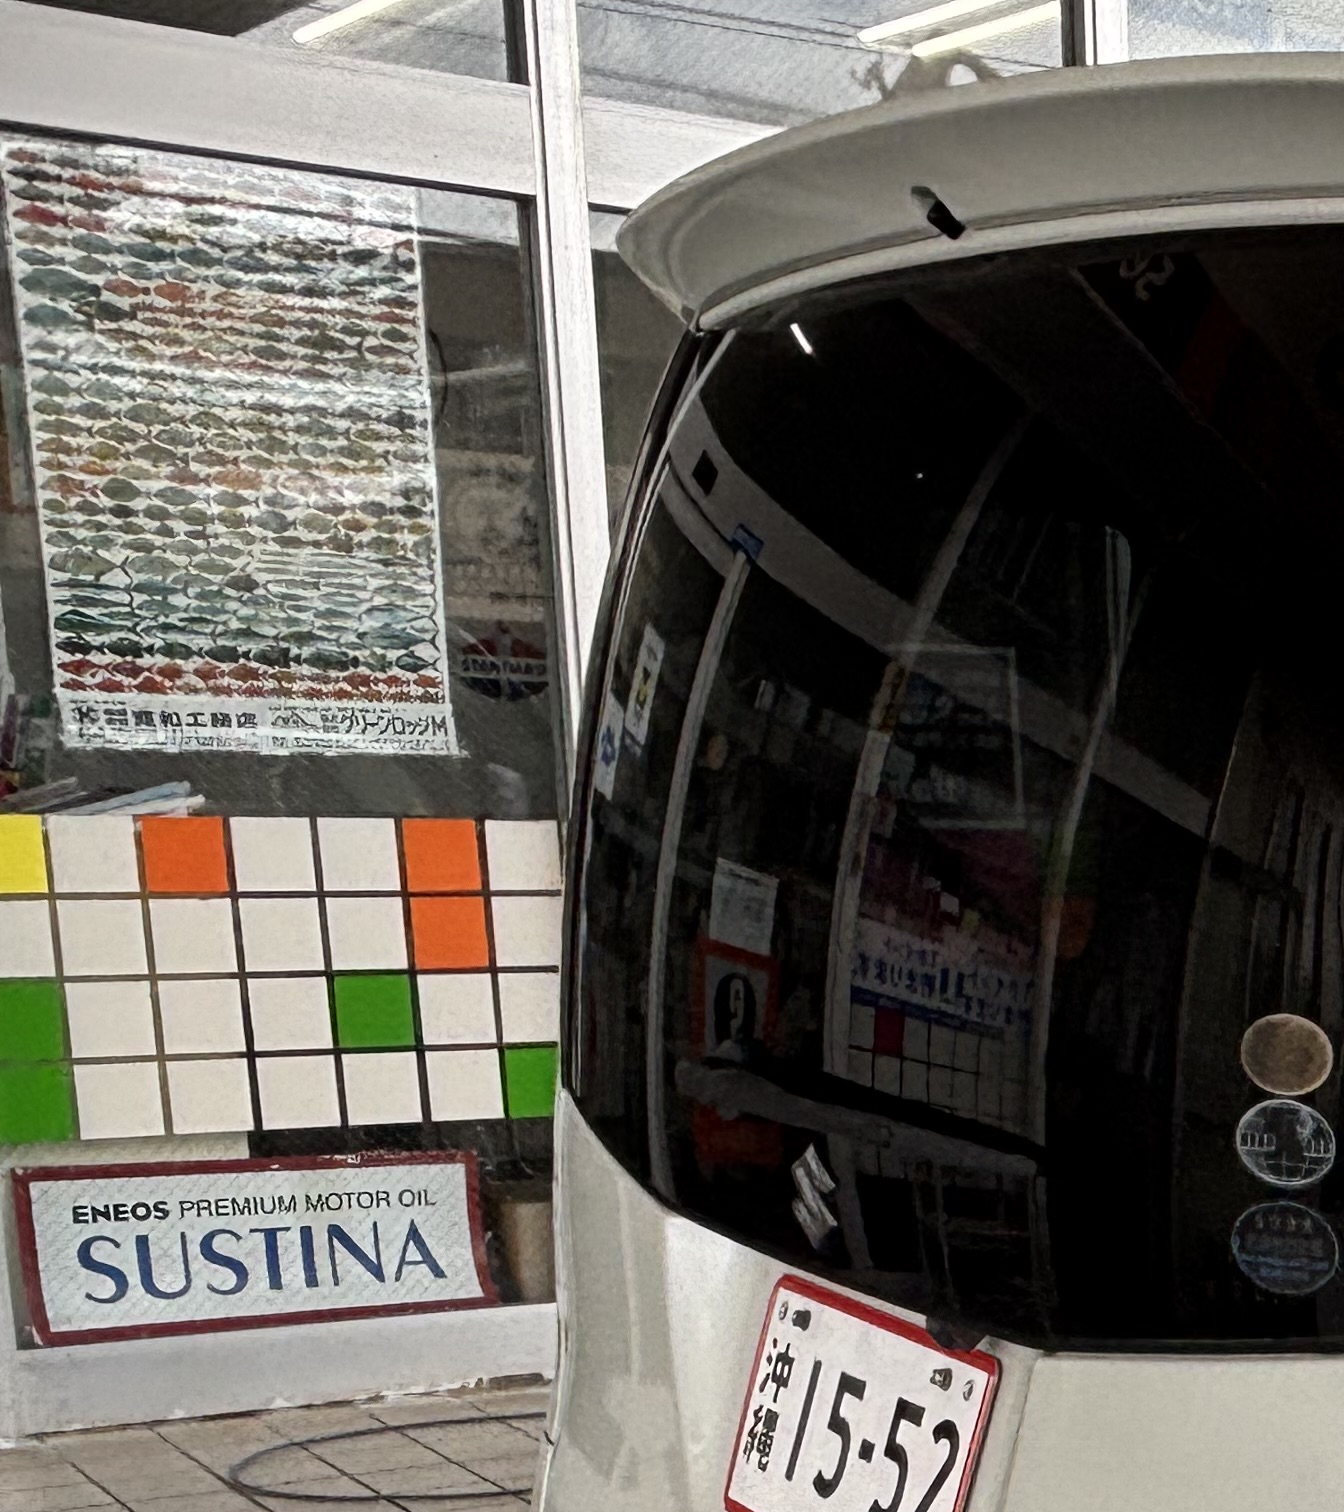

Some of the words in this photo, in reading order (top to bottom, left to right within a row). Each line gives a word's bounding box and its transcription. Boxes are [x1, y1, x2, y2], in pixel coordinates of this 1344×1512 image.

[72, 1200, 170, 1225] ENEOS
[178, 1194, 298, 1220] PREMIUM
[304, 1190, 391, 1213] MOTOR
[397, 1188, 437, 1208] OIL
[76, 1218, 447, 1304] SUSTINA
